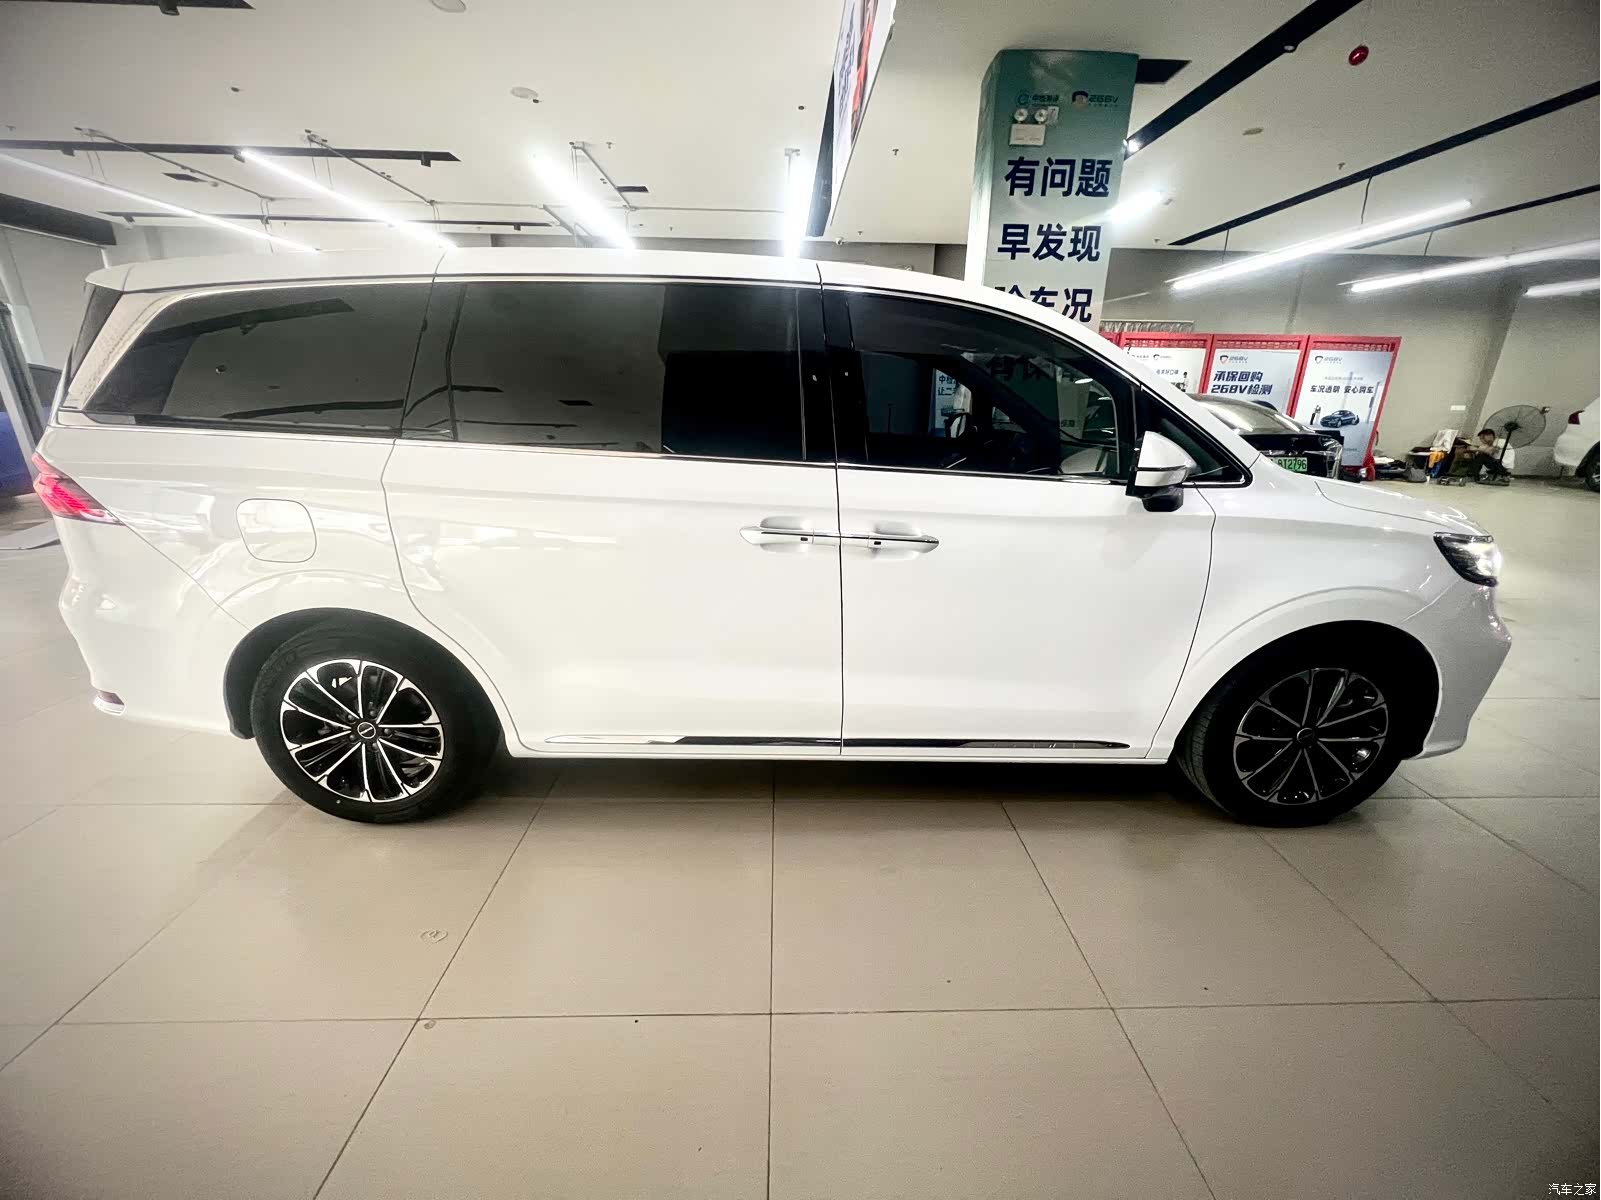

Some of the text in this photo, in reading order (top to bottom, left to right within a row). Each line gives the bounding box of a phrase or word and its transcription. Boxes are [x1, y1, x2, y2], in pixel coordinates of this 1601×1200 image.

[1004, 156, 1113, 198] 有问题
[997, 223, 1102, 262] 早发现
[938, 374, 957, 384] 中检
[1213, 370, 1264, 382] 承保回购
[1211, 384, 1273, 395] 268V检测
